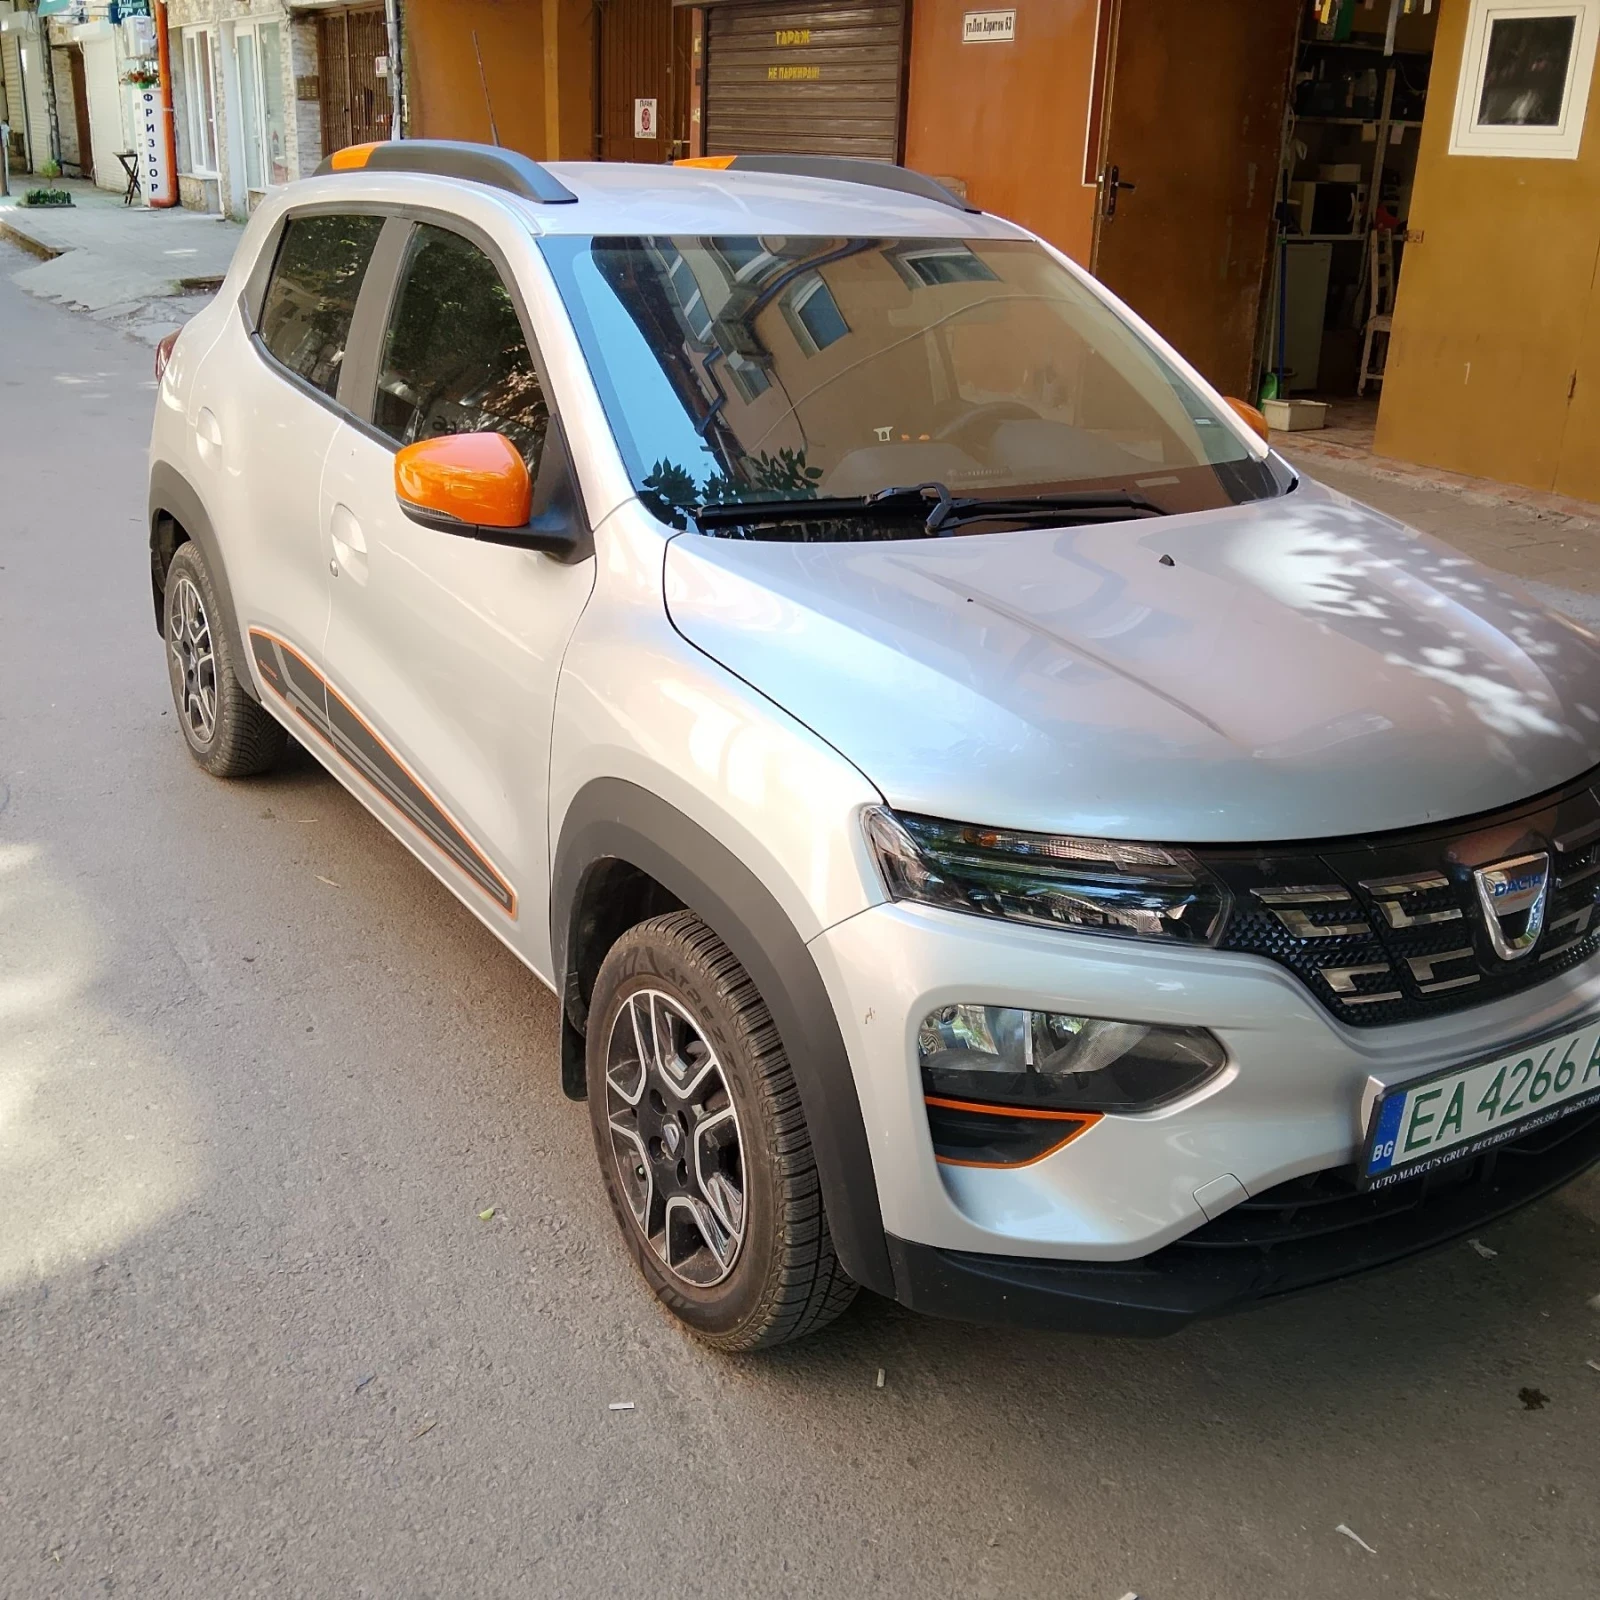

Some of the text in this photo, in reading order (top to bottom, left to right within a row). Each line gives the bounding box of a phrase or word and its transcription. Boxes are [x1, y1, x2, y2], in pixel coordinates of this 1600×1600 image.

[776, 29, 810, 45] ГАРАЖ
[768, 67, 778, 79] НЕ
[143, 93, 159, 192] ФРИЗЬОР
[1494, 873, 1544, 896] DACIA
[1404, 1081, 1465, 1153] EA
[1477, 1037, 1580, 1121] 4266
[1372, 1141, 1394, 1162] BG
[1368, 1173, 1397, 1192] AUTO
[1442, 1146, 1469, 1164] GRUP
